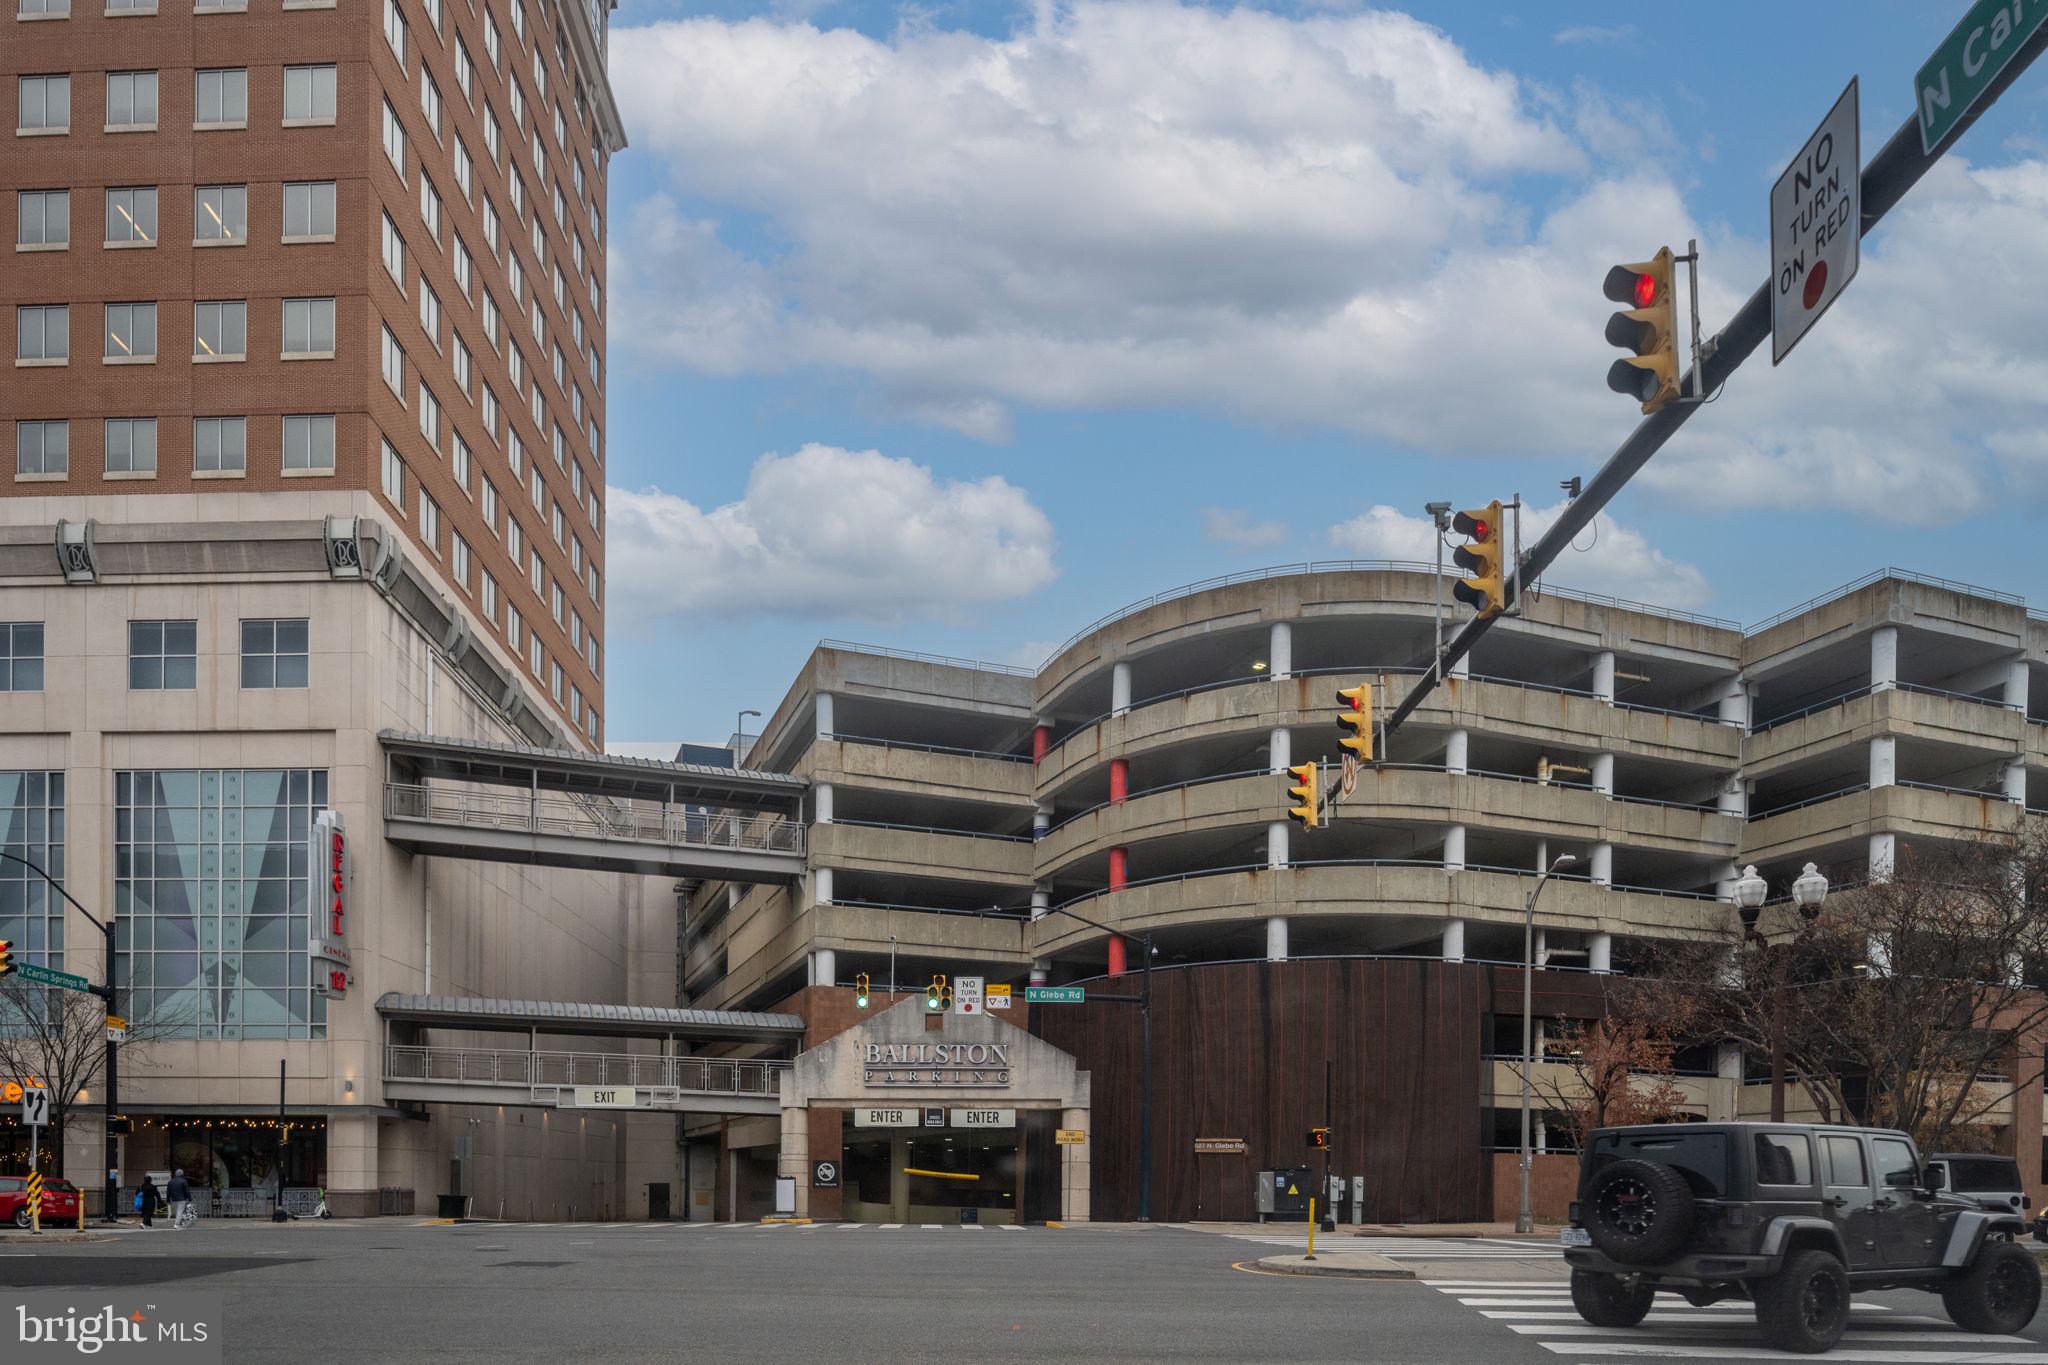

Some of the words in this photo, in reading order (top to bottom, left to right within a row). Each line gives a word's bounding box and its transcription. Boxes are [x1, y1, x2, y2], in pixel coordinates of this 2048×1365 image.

[1923, 66, 1951, 128] N
[1795, 132, 1833, 205] NO
[1790, 166, 1839, 245] TURN
[1780, 250, 1805, 295] ON
[1815, 195, 1850, 256] RED
[332, 833, 344, 936] REGAL
[18, 965, 25, 975] N
[26, 968, 49, 981] Carlin
[50, 973, 78, 988] Springs
[79, 980, 88, 990] Rd
[962, 980, 976, 988] NO
[1029, 991, 1037, 999] N
[1040, 990, 1065, 999] Glebe
[1068, 990, 1080, 999] Rd
[864, 1043, 1009, 1065] BALLSTON
[864, 1070, 1009, 1083] PARKING
[594, 1091, 616, 1103] EXIT
[870, 1110, 903, 1123] ENTER
[966, 1111, 1000, 1124] ENTER
